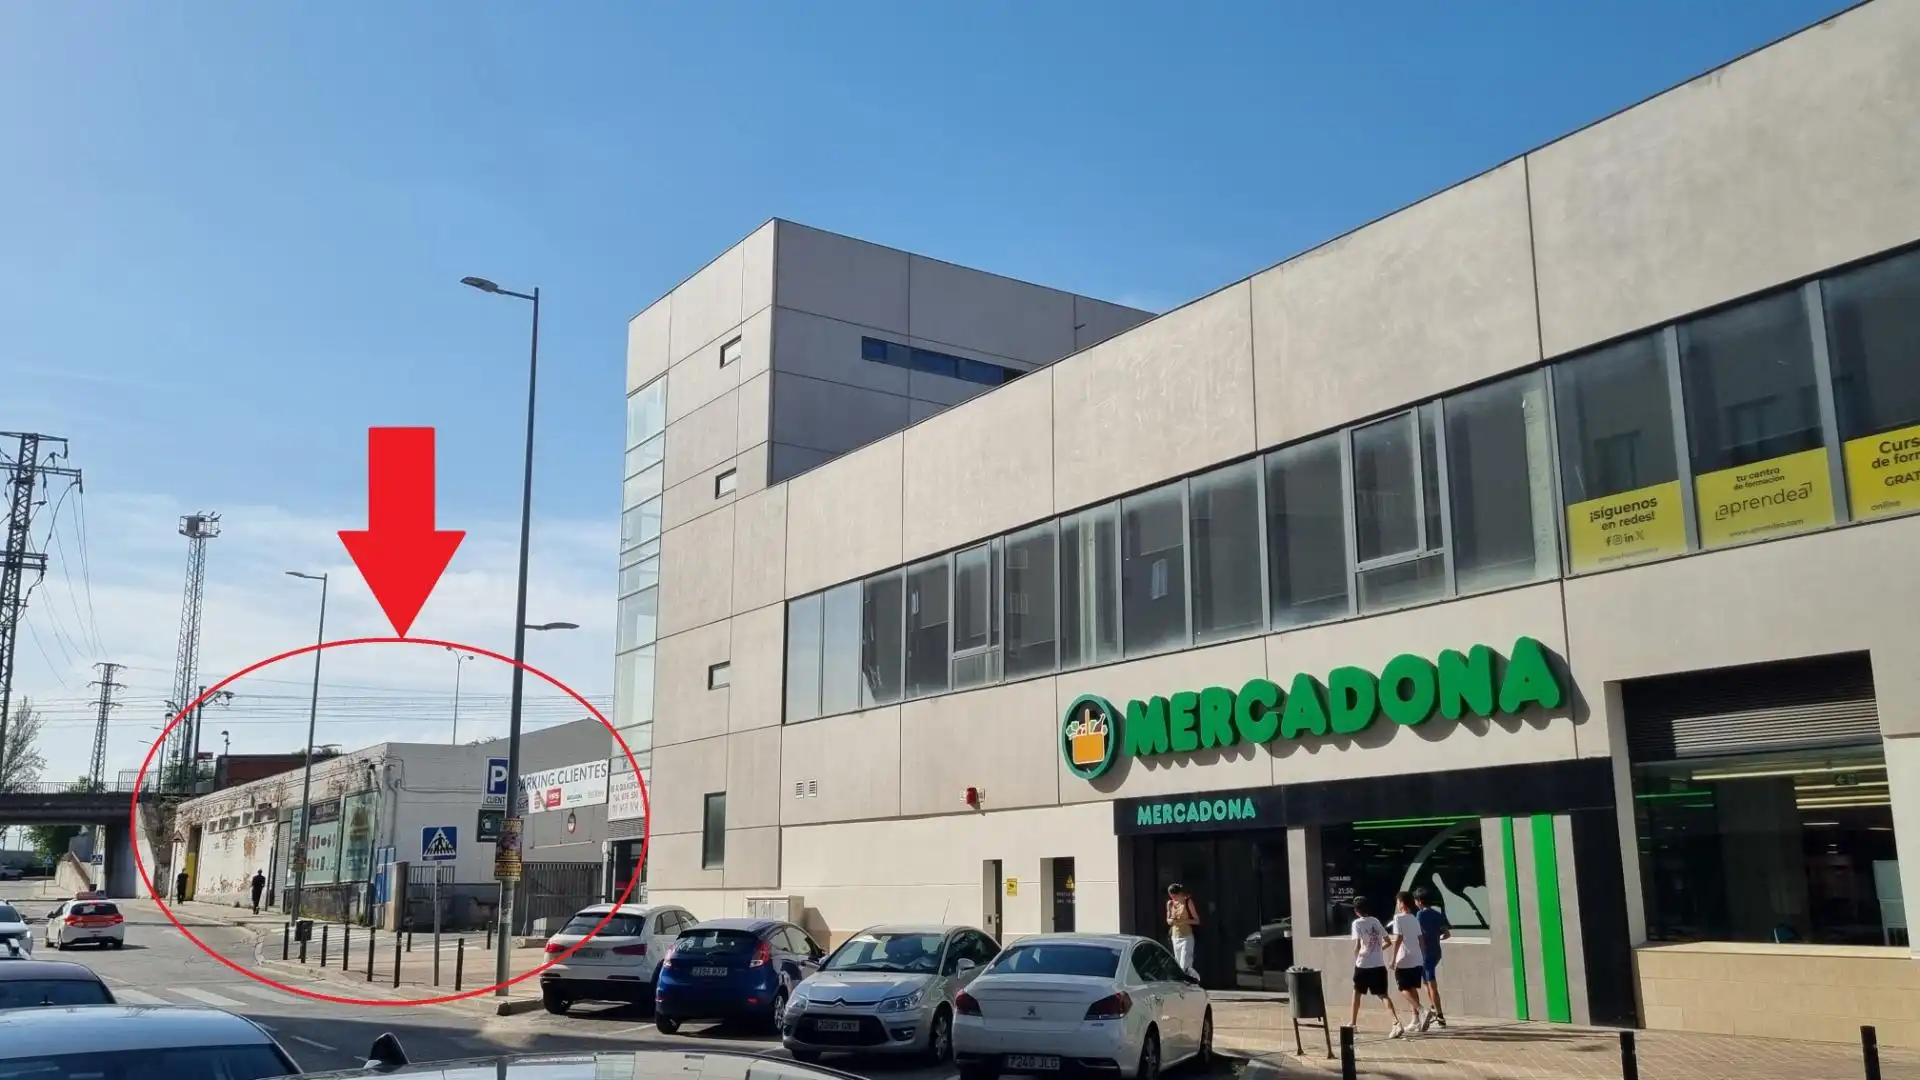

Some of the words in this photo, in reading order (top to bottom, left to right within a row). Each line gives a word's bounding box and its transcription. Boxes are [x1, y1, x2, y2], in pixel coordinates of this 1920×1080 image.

[1872, 458, 1890, 469] de
[1736, 474, 1746, 482] tu
[1748, 467, 1780, 480] centro
[1601, 520, 1616, 531] en
[1619, 511, 1656, 527] redes!
[1125, 636, 1566, 758] MERCADONA
[490, 765, 507, 792] P
[557, 762, 607, 785] CLIENTES
[486, 796, 506, 805] CLIENT
[1137, 798, 1256, 826] MERCADONA
